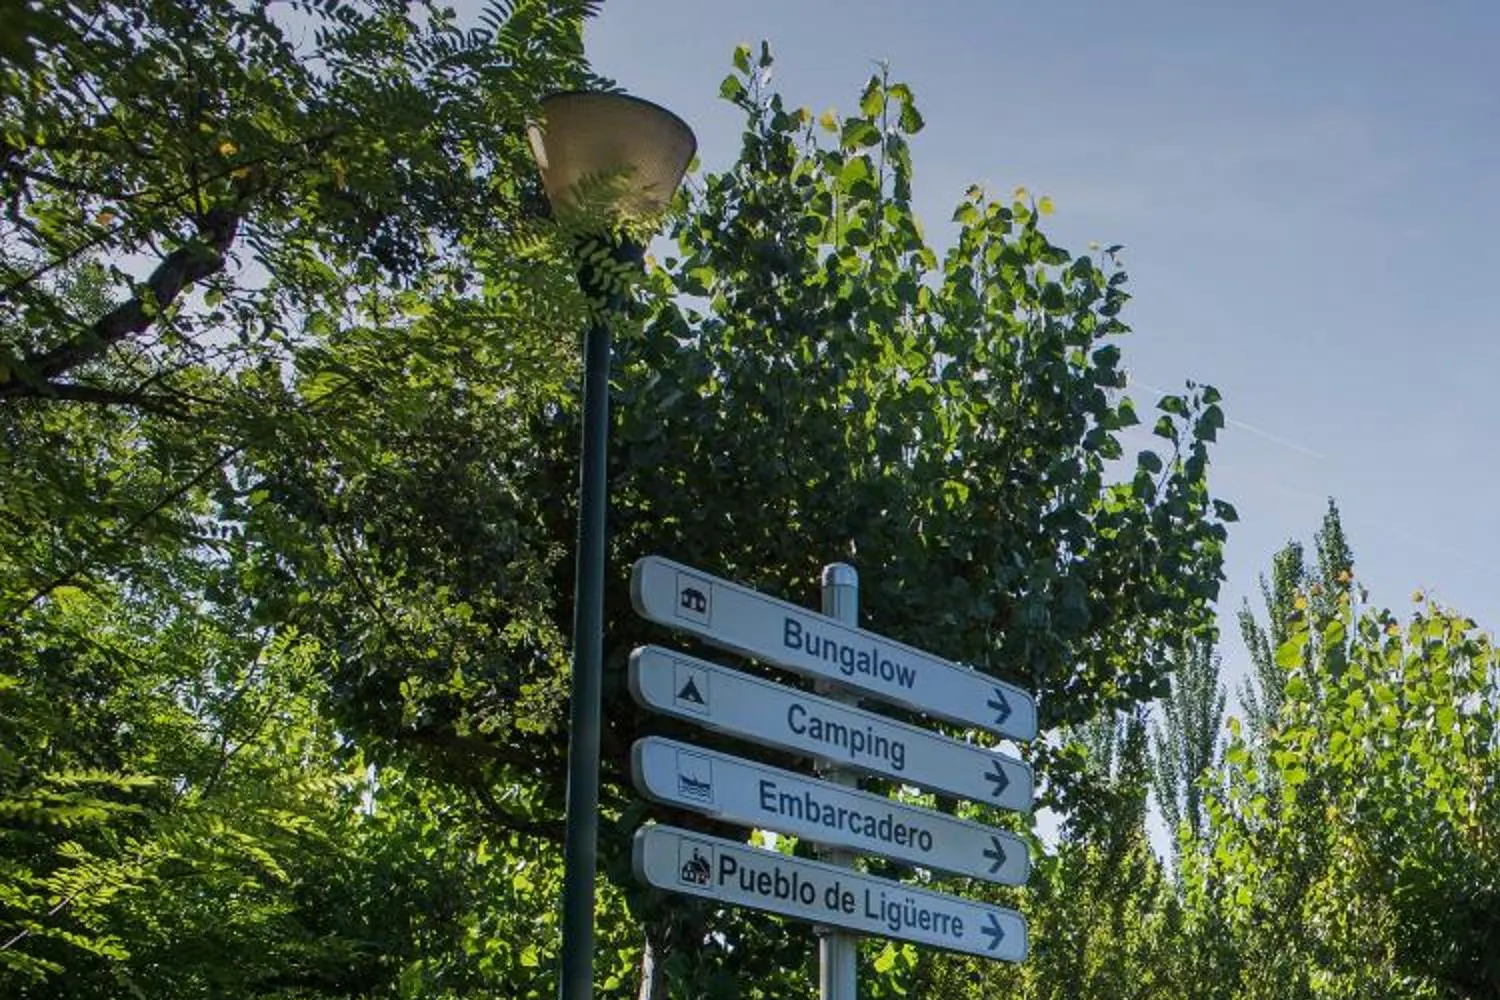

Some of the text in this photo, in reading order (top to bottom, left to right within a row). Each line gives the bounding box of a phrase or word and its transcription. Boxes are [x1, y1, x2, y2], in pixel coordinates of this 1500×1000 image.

[784, 617, 916, 689] Bungalow
[787, 703, 906, 771] Camping
[759, 781, 933, 852] Embarcadero
[718, 855, 964, 938] Pueblo de Ligüerre
